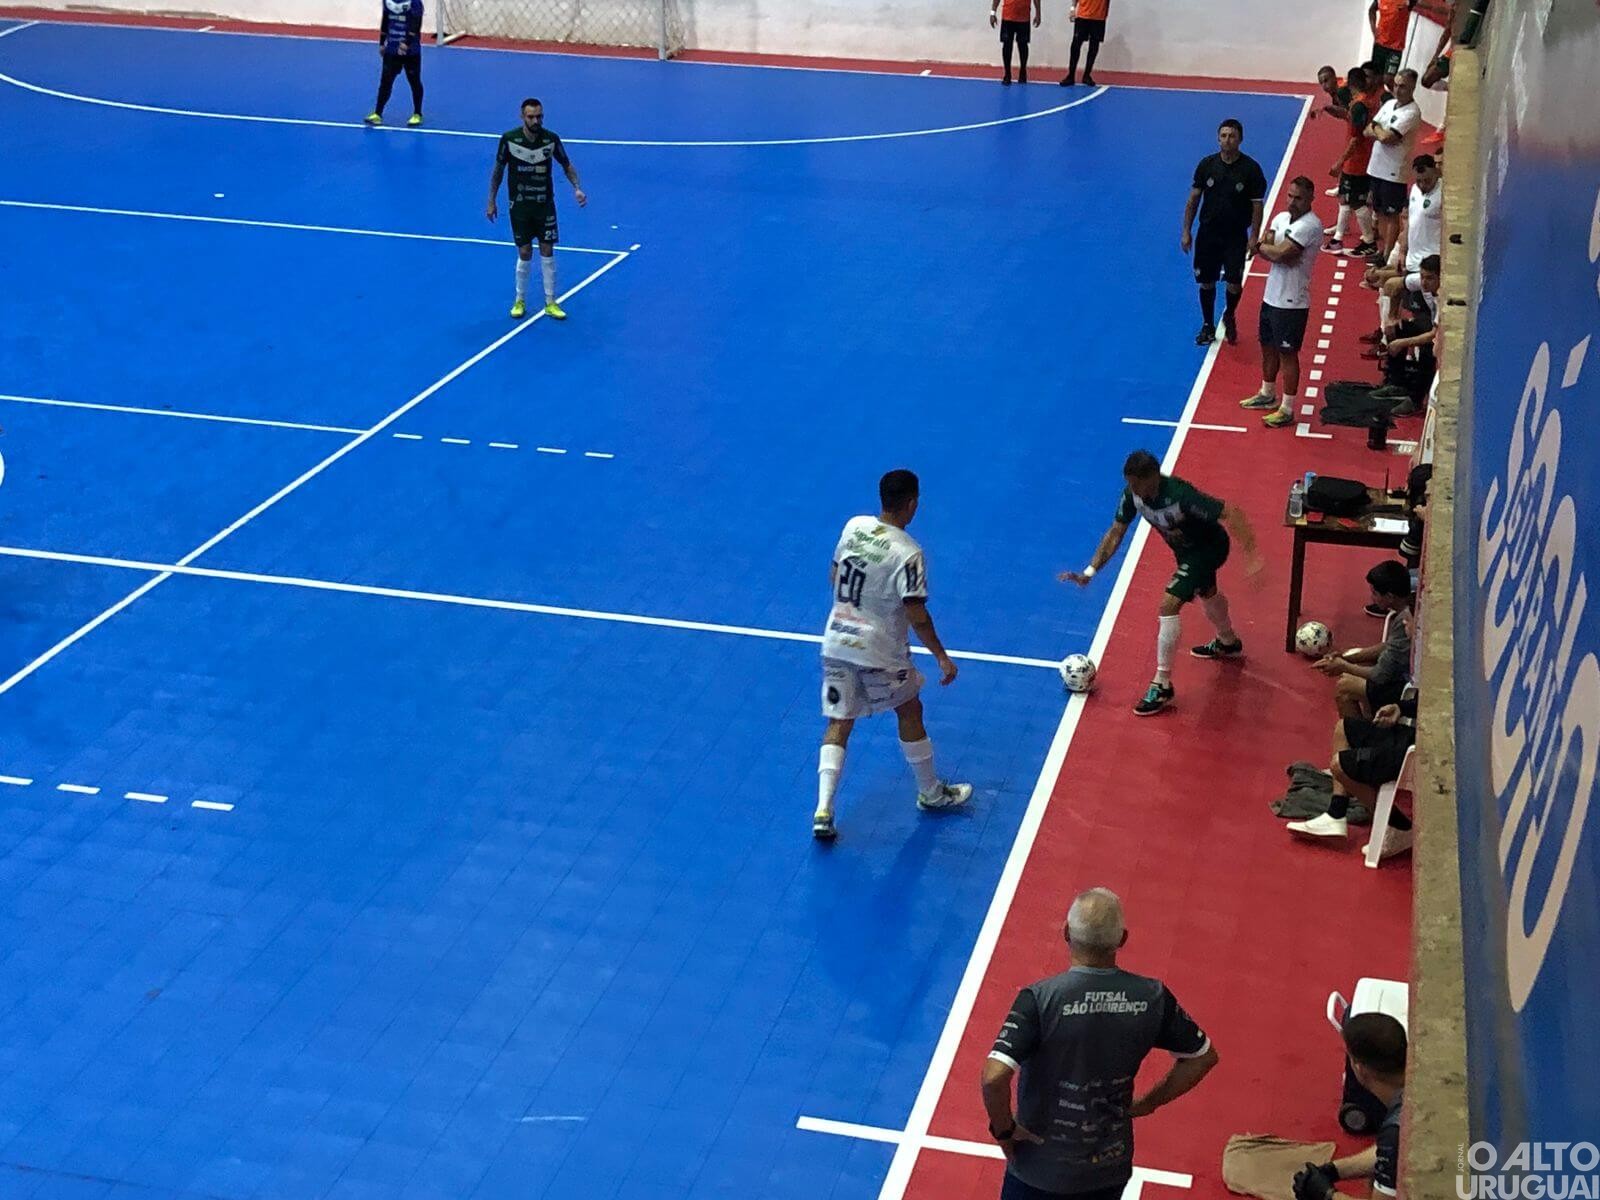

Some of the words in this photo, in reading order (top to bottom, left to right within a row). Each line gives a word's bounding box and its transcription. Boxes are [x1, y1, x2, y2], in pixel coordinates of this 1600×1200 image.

[838, 558, 866, 608] 20
[1506, 467, 1560, 799] GUARANI
[1062, 1001, 1088, 1015] SÃO
[1089, 1001, 1148, 1015] LOURENÇO
[1084, 991, 1127, 1002] FUTSAL
